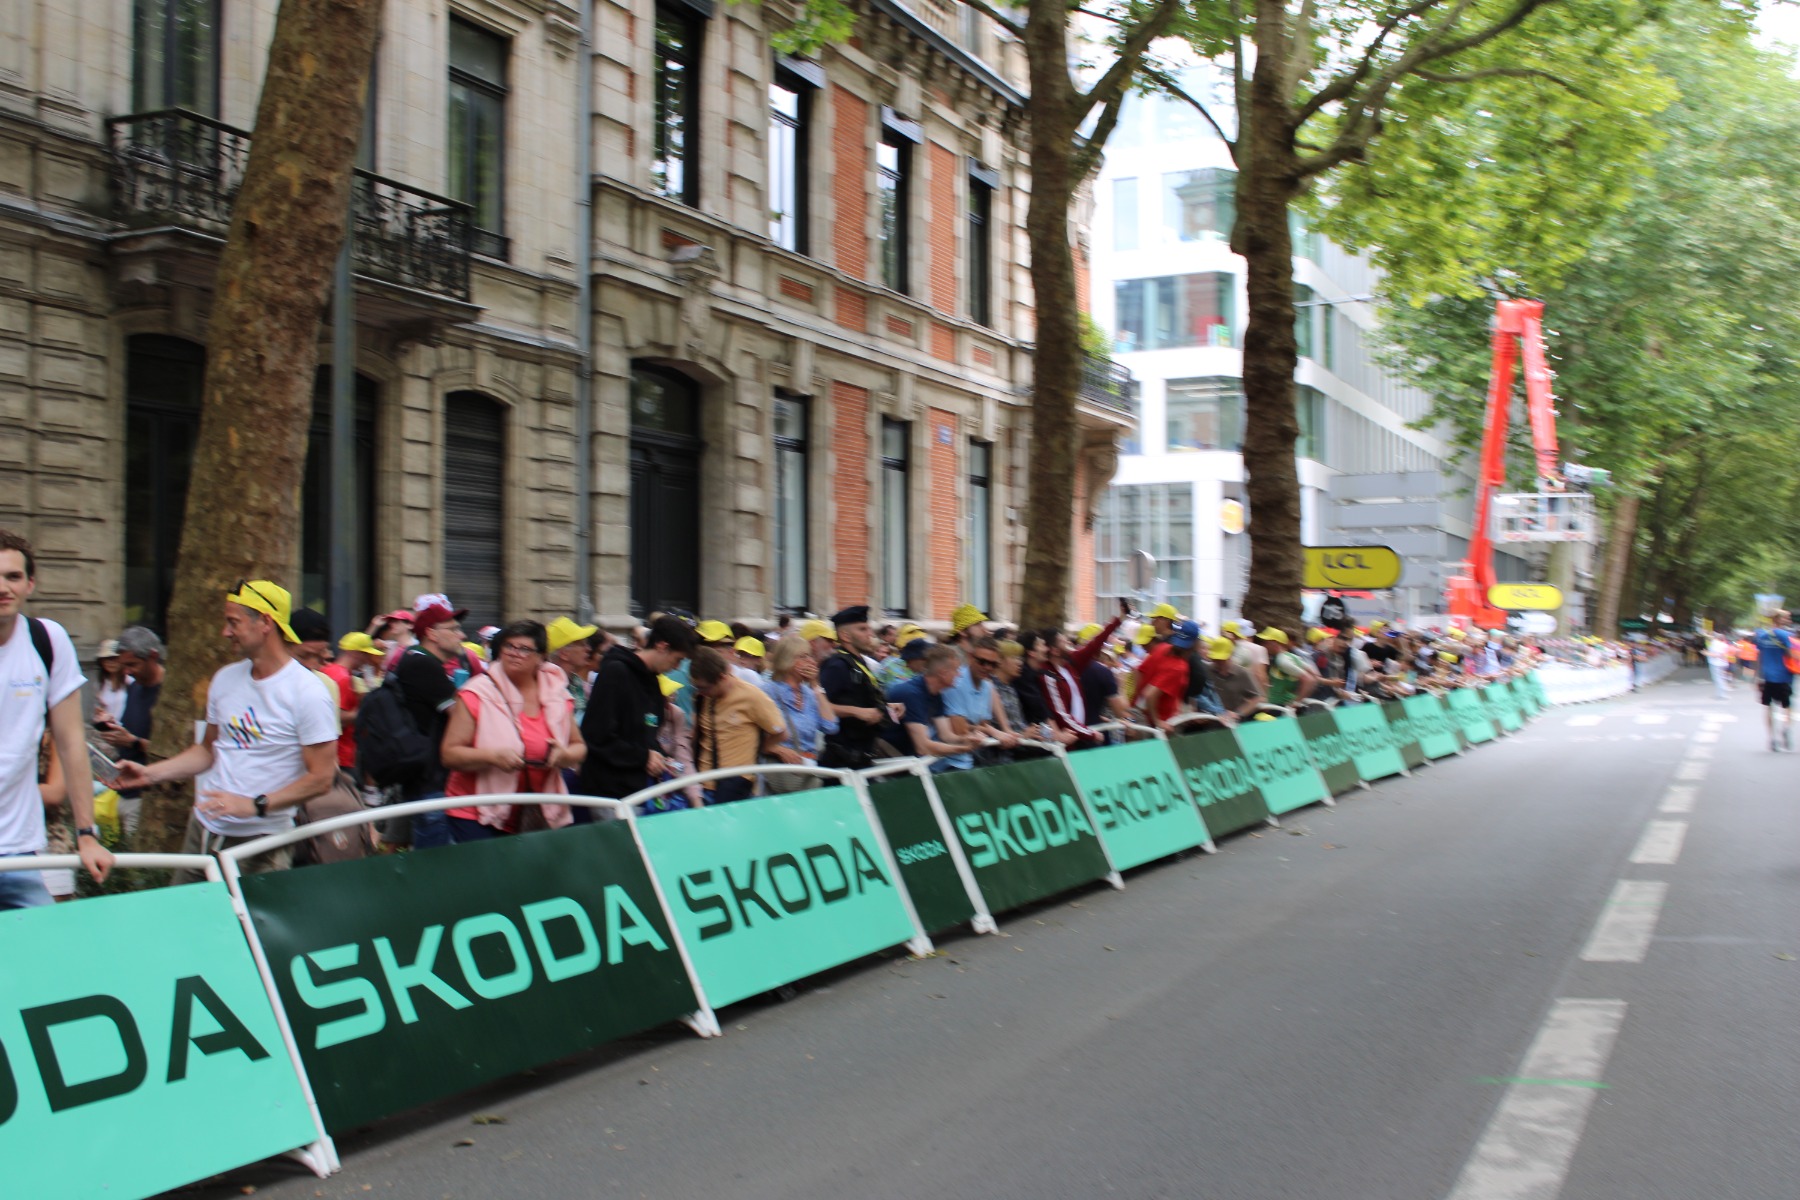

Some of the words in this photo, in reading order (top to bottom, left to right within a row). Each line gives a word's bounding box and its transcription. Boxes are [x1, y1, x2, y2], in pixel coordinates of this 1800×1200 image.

[1322, 553, 1372, 570] LCL
[1089, 771, 1193, 831] SKODA
[1183, 756, 1257, 807] SKODA
[895, 839, 948, 865] SKODA
[956, 793, 1096, 868] SKODA
[678, 836, 892, 940] SKODA
[289, 884, 668, 1050] SKODA
[0, 974, 271, 1126] DA
